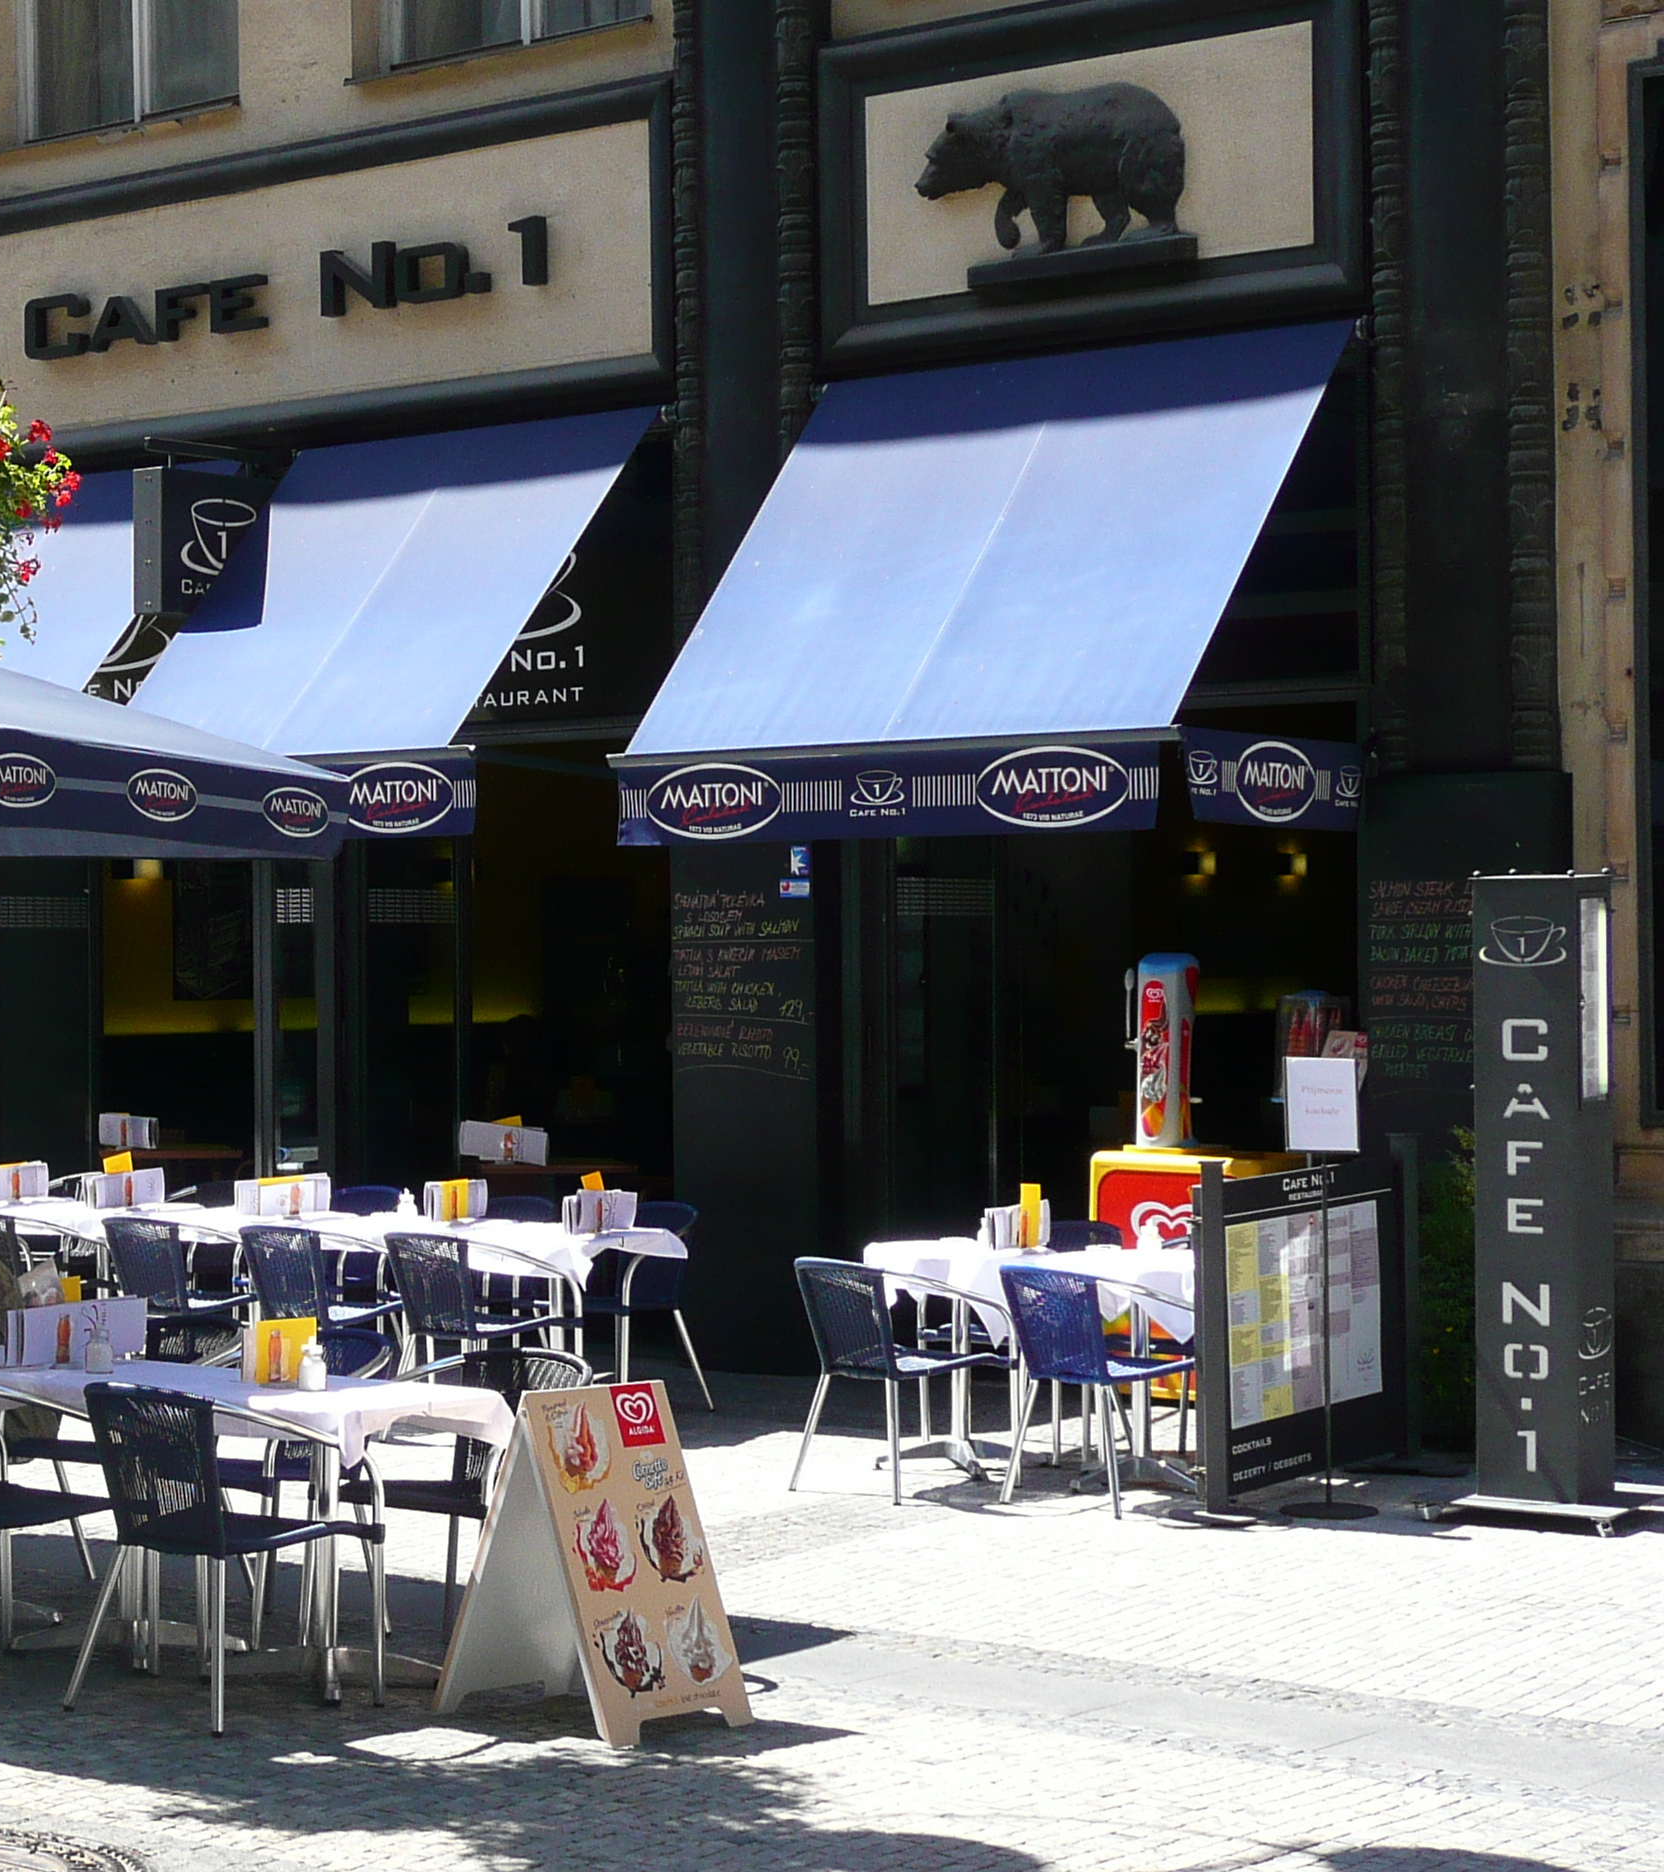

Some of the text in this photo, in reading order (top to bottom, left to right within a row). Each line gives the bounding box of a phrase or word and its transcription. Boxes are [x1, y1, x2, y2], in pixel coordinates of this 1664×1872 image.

[24, 274, 269, 361] CAFE
[181, 578, 212, 597] CA
[991, 765, 1108, 796] MATTONI
[1244, 760, 1307, 791] MATTONI
[136, 779, 189, 802] MATTONI
[348, 778, 438, 806] MATTONI
[660, 781, 763, 810] MATTONI
[270, 796, 323, 818] MATTONI
[849, 809, 877, 818] CAFE
[1413, 881, 1455, 897] STEAK
[1502, 1018, 1551, 1234] CAFE
[1283, 1177, 1308, 1191] CAFE
[628, 1425, 655, 1436] ALGIDA
[1231, 1436, 1272, 1455] COCKTAILS
[1233, 1465, 1267, 1482] DEZERTY
[1273, 1453, 1312, 1471] DESSERTS
